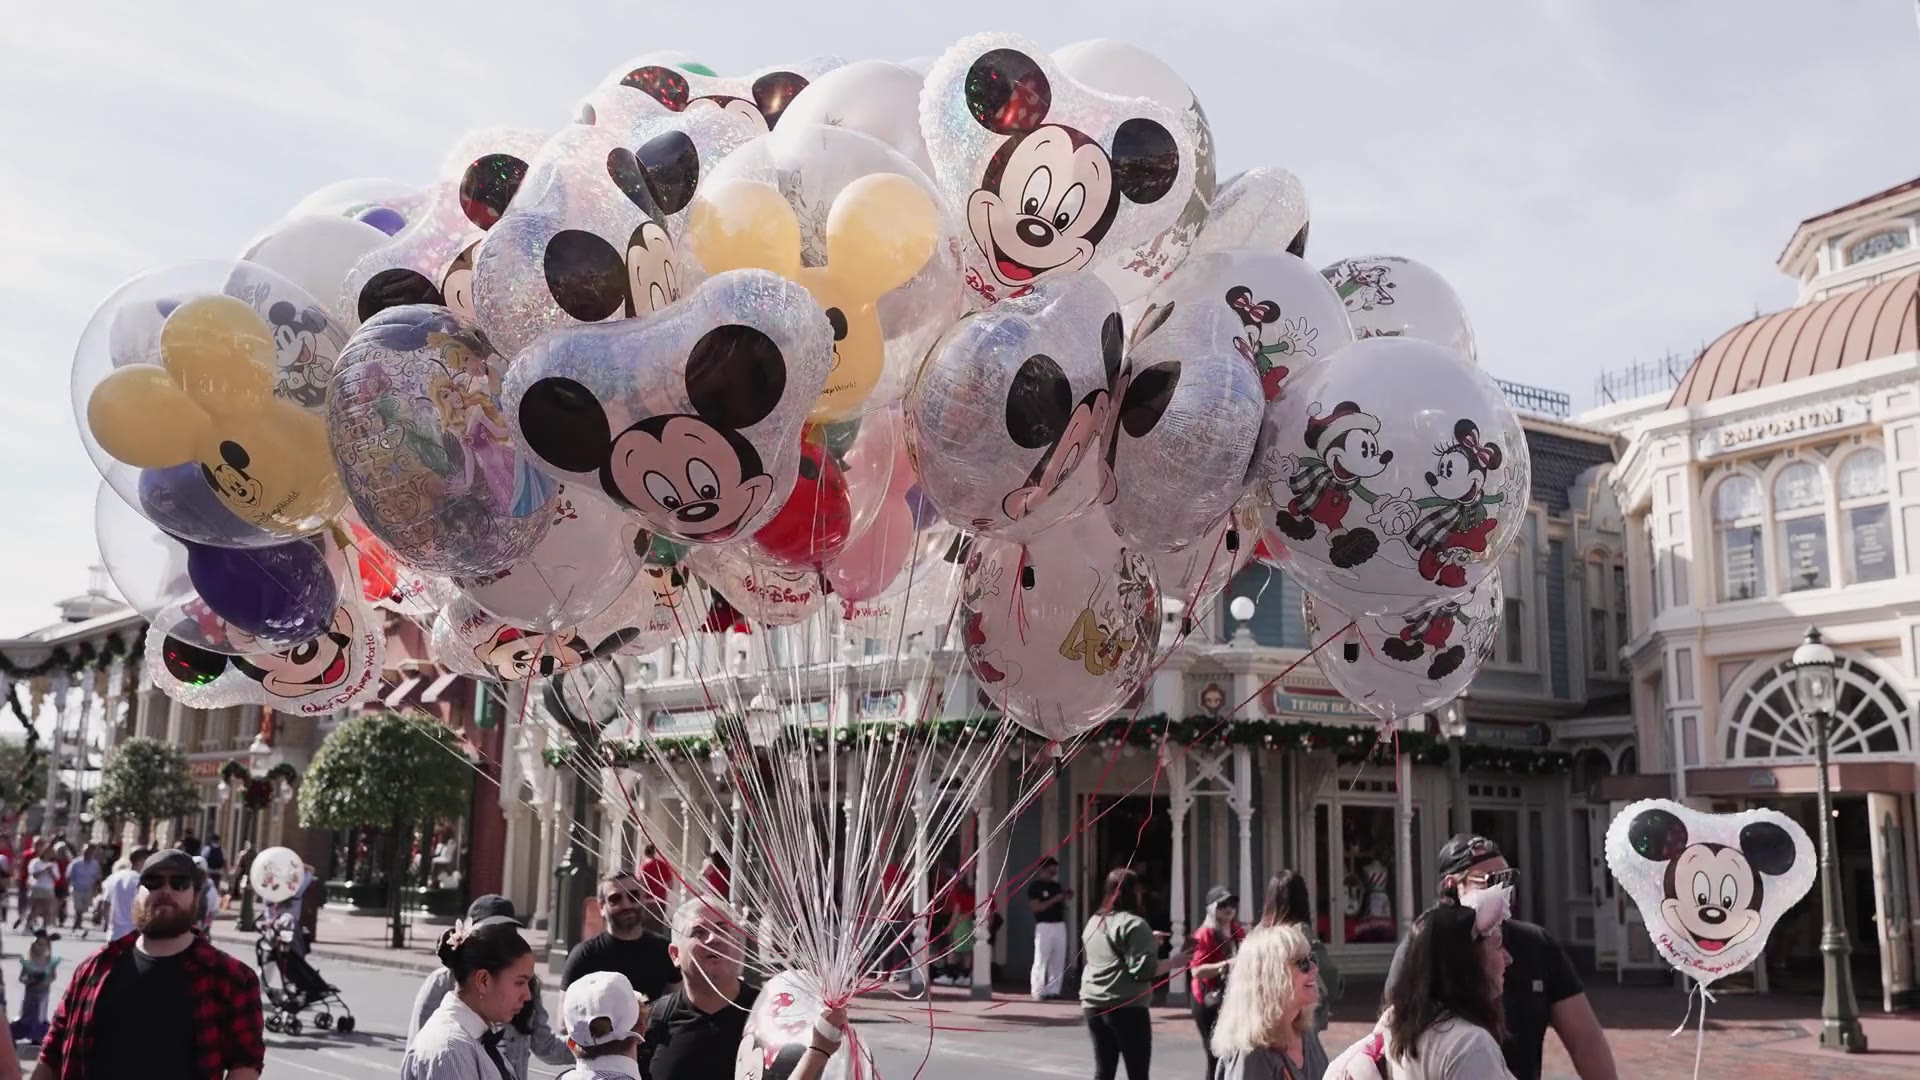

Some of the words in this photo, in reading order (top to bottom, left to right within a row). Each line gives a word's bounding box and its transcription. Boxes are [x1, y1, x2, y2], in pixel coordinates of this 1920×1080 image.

[834, 380, 857, 392] World
[1723, 406, 1843, 447] EMPORIUM
[327, 669, 373, 704] Disney
[364, 631, 376, 668] World
[1290, 698, 1329, 712] TEDDY
